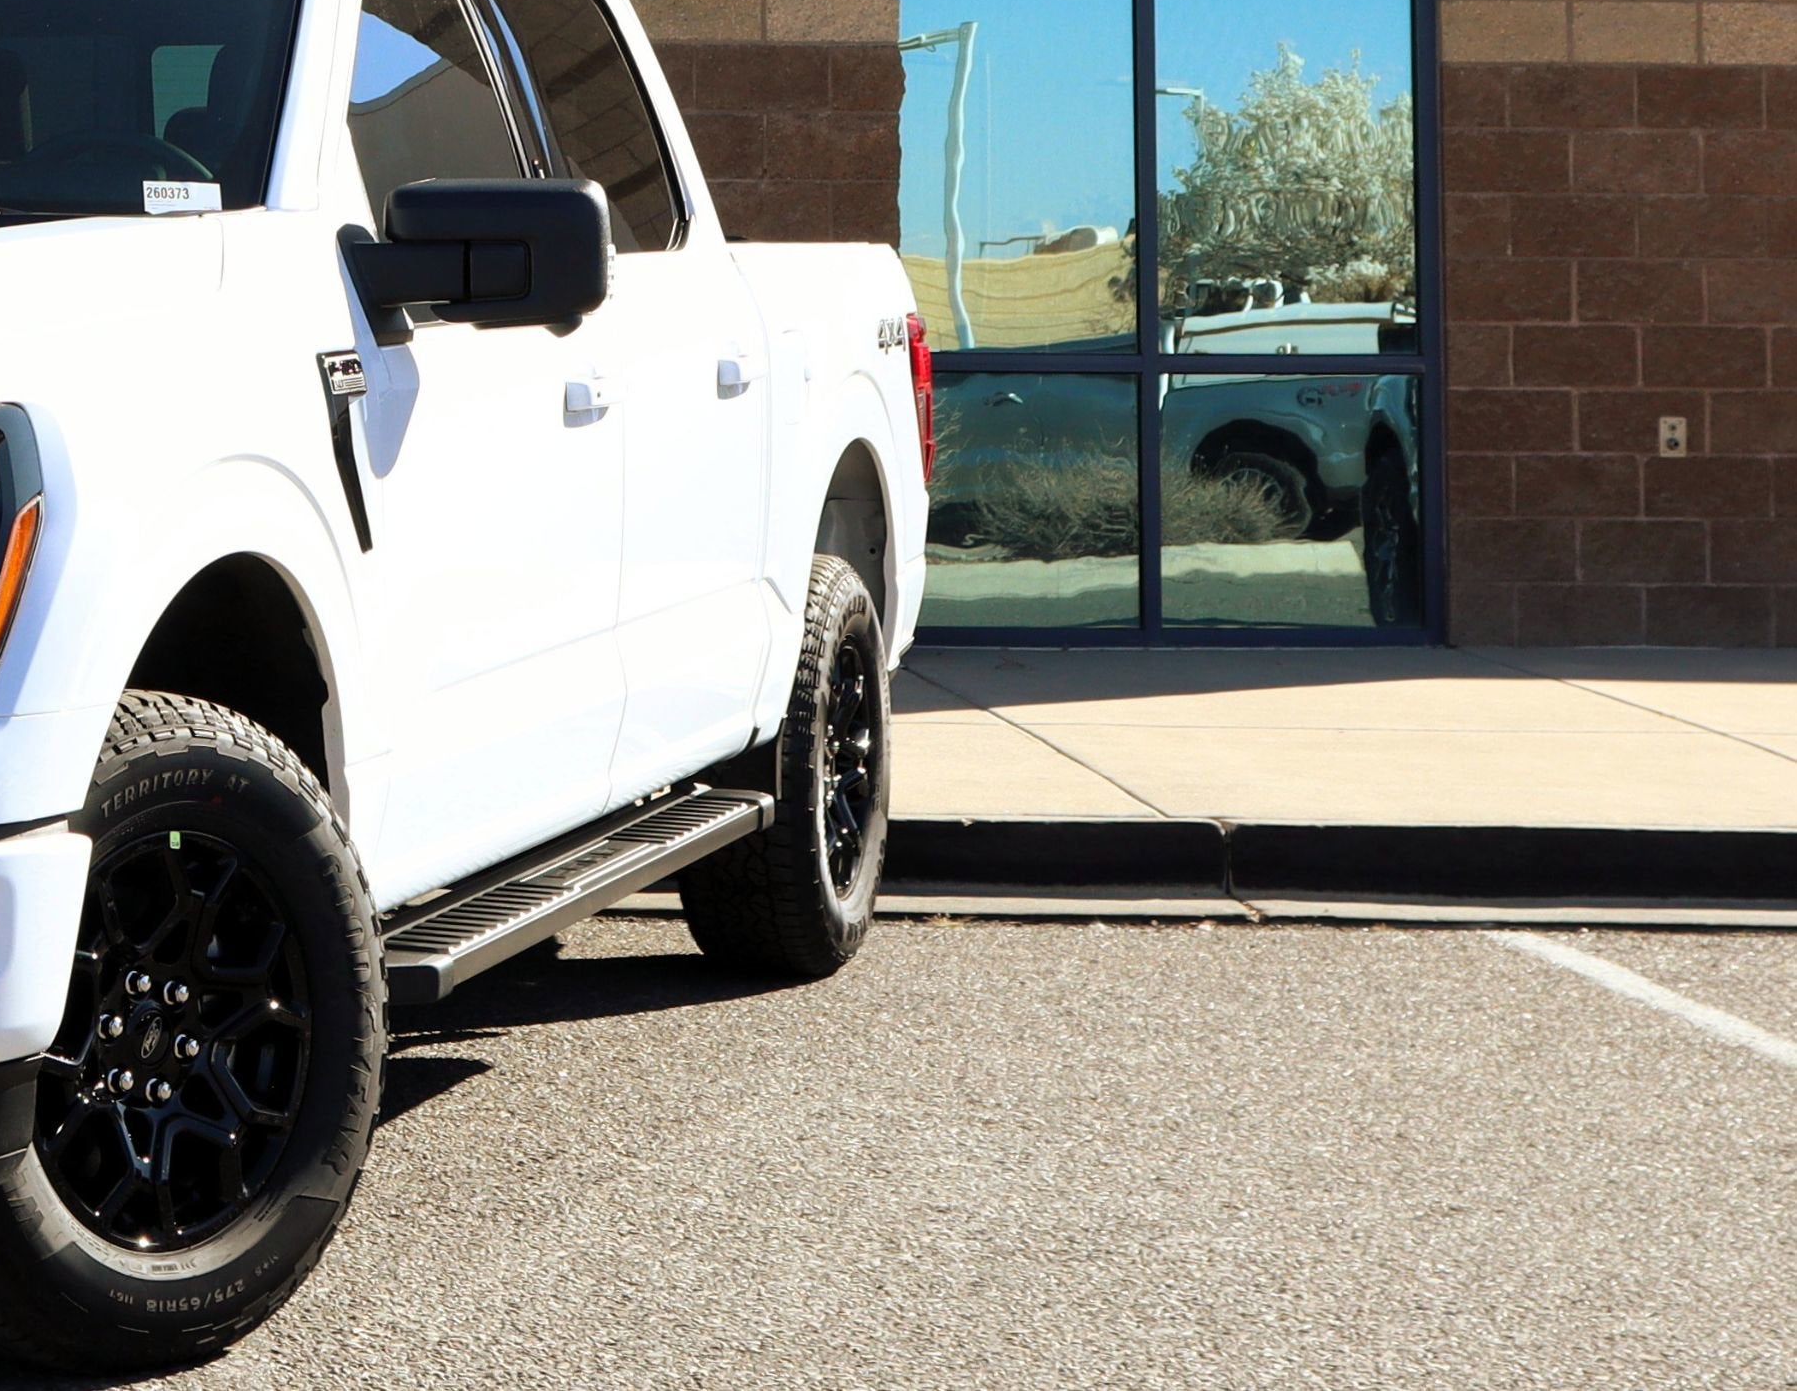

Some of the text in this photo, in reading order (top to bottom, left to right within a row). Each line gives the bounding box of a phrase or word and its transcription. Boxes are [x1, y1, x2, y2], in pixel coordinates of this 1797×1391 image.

[146, 186, 189, 199] 260373
[100, 768, 214, 818] TERRITORY
[146, 1278, 245, 1312] 275/65R18
